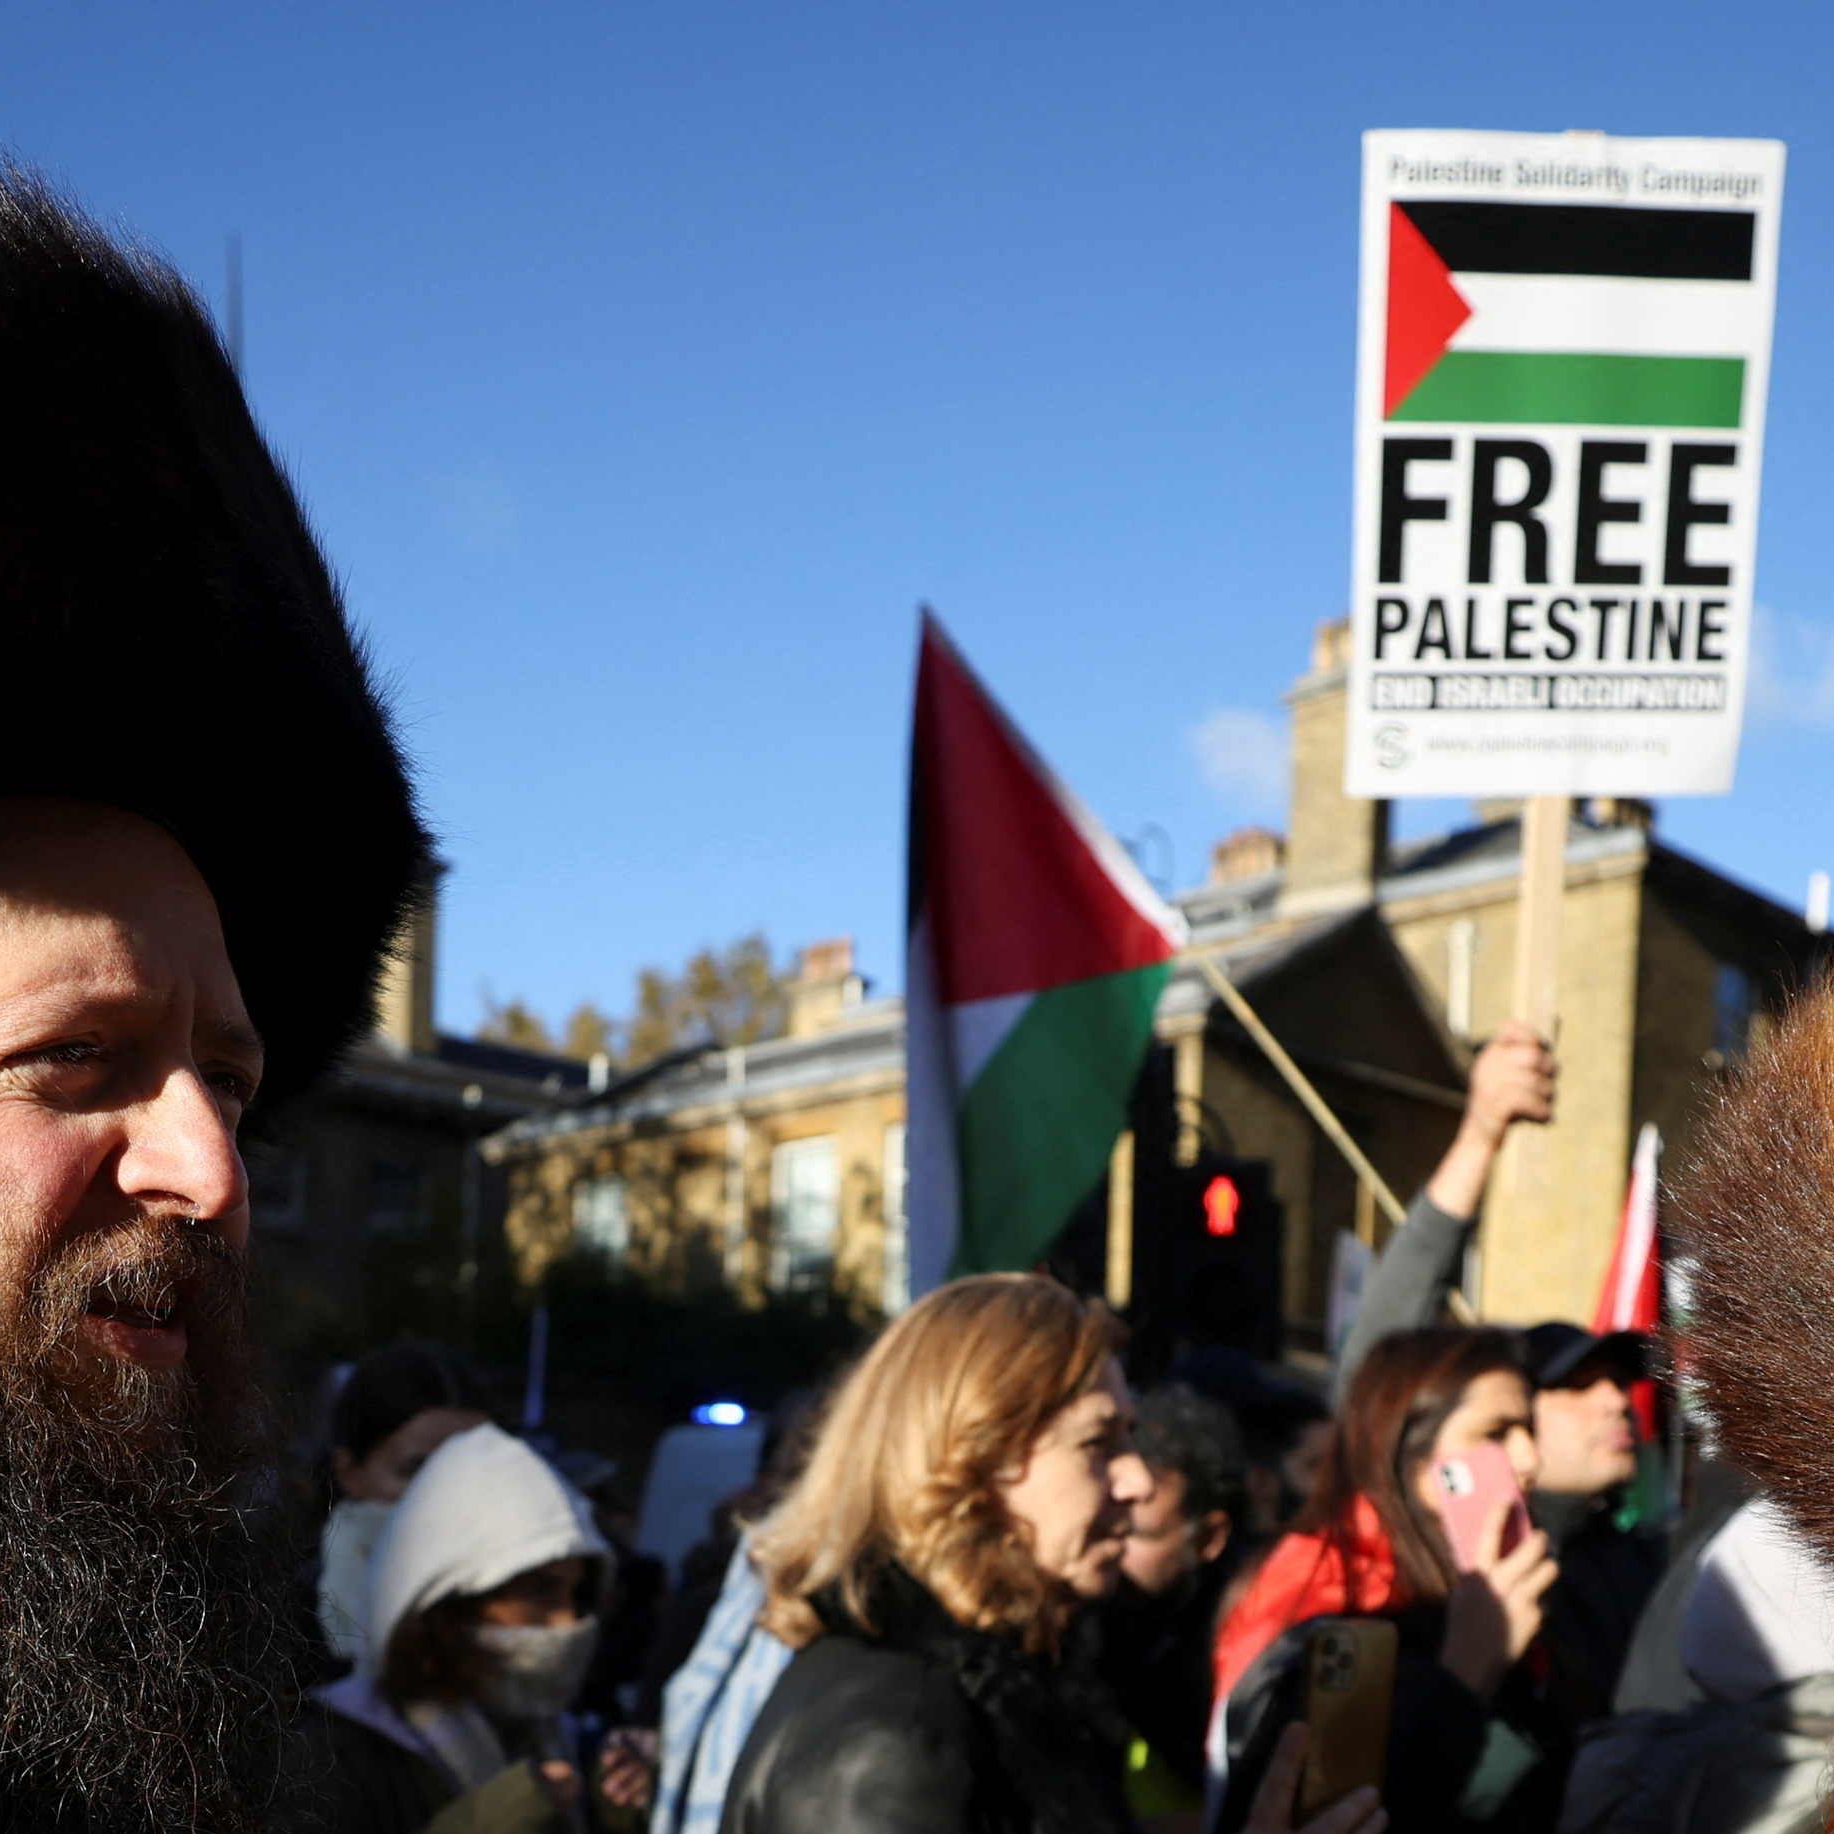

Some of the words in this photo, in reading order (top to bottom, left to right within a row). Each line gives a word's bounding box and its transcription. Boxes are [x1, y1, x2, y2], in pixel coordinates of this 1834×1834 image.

[1389, 155, 1504, 184] Palestine
[1514, 157, 1631, 194] Solidarity
[1640, 165, 1764, 197] Campaign
[1376, 436, 1739, 587] FREE
[1372, 595, 1728, 663] PALESTINE
[1375, 673, 1436, 711] END
[1436, 674, 1551, 711] ISRAELI
[1552, 676, 1725, 710] OCCUPATION
